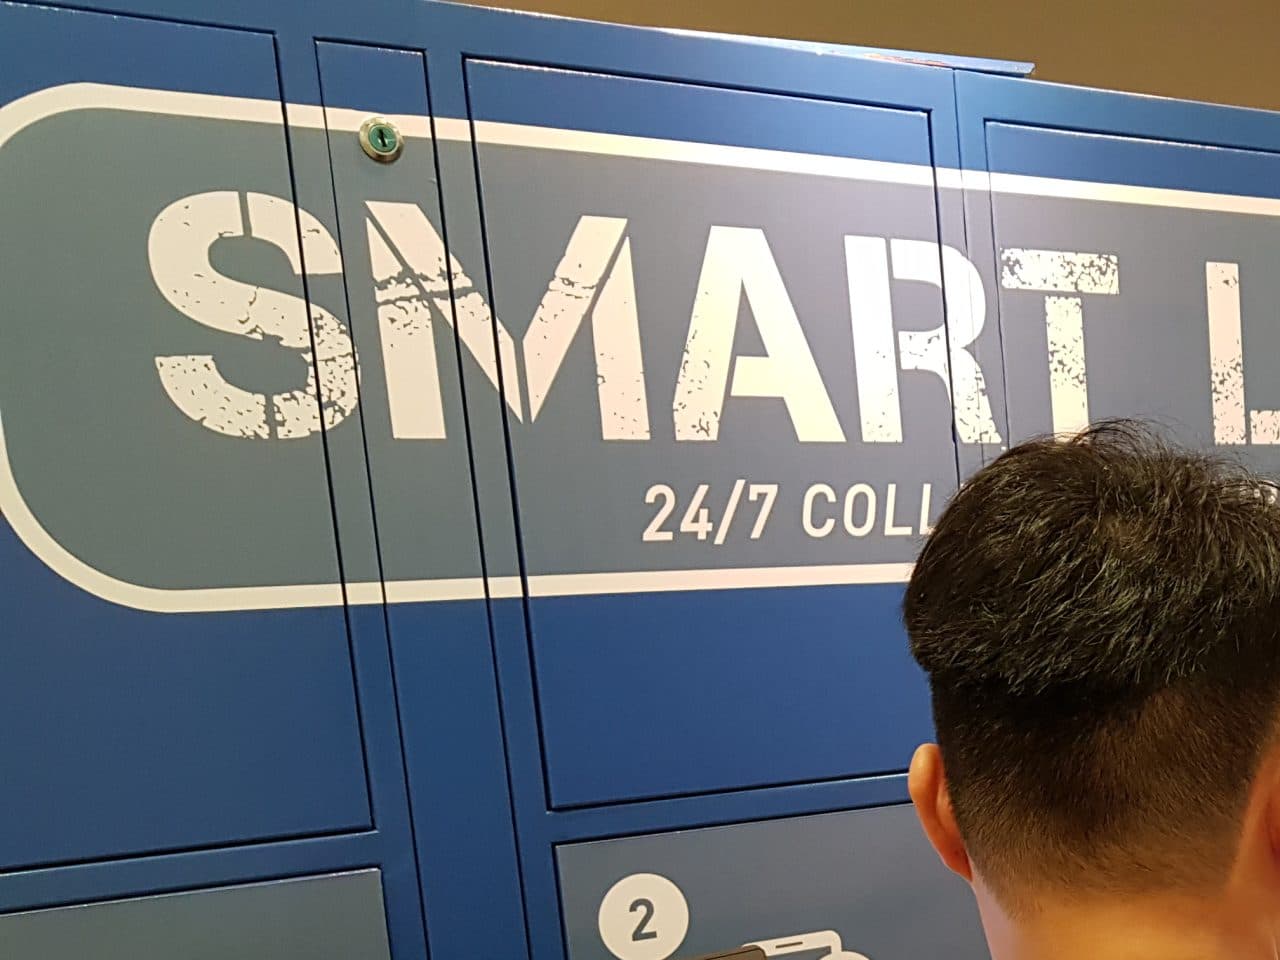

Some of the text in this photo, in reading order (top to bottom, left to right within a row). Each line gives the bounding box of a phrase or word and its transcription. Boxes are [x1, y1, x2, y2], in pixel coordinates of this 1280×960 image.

[148, 190, 1119, 444] SMART
[643, 479, 778, 545] 24/7
[802, 483, 932, 538] COLL
[628, 898, 658, 942] 2
